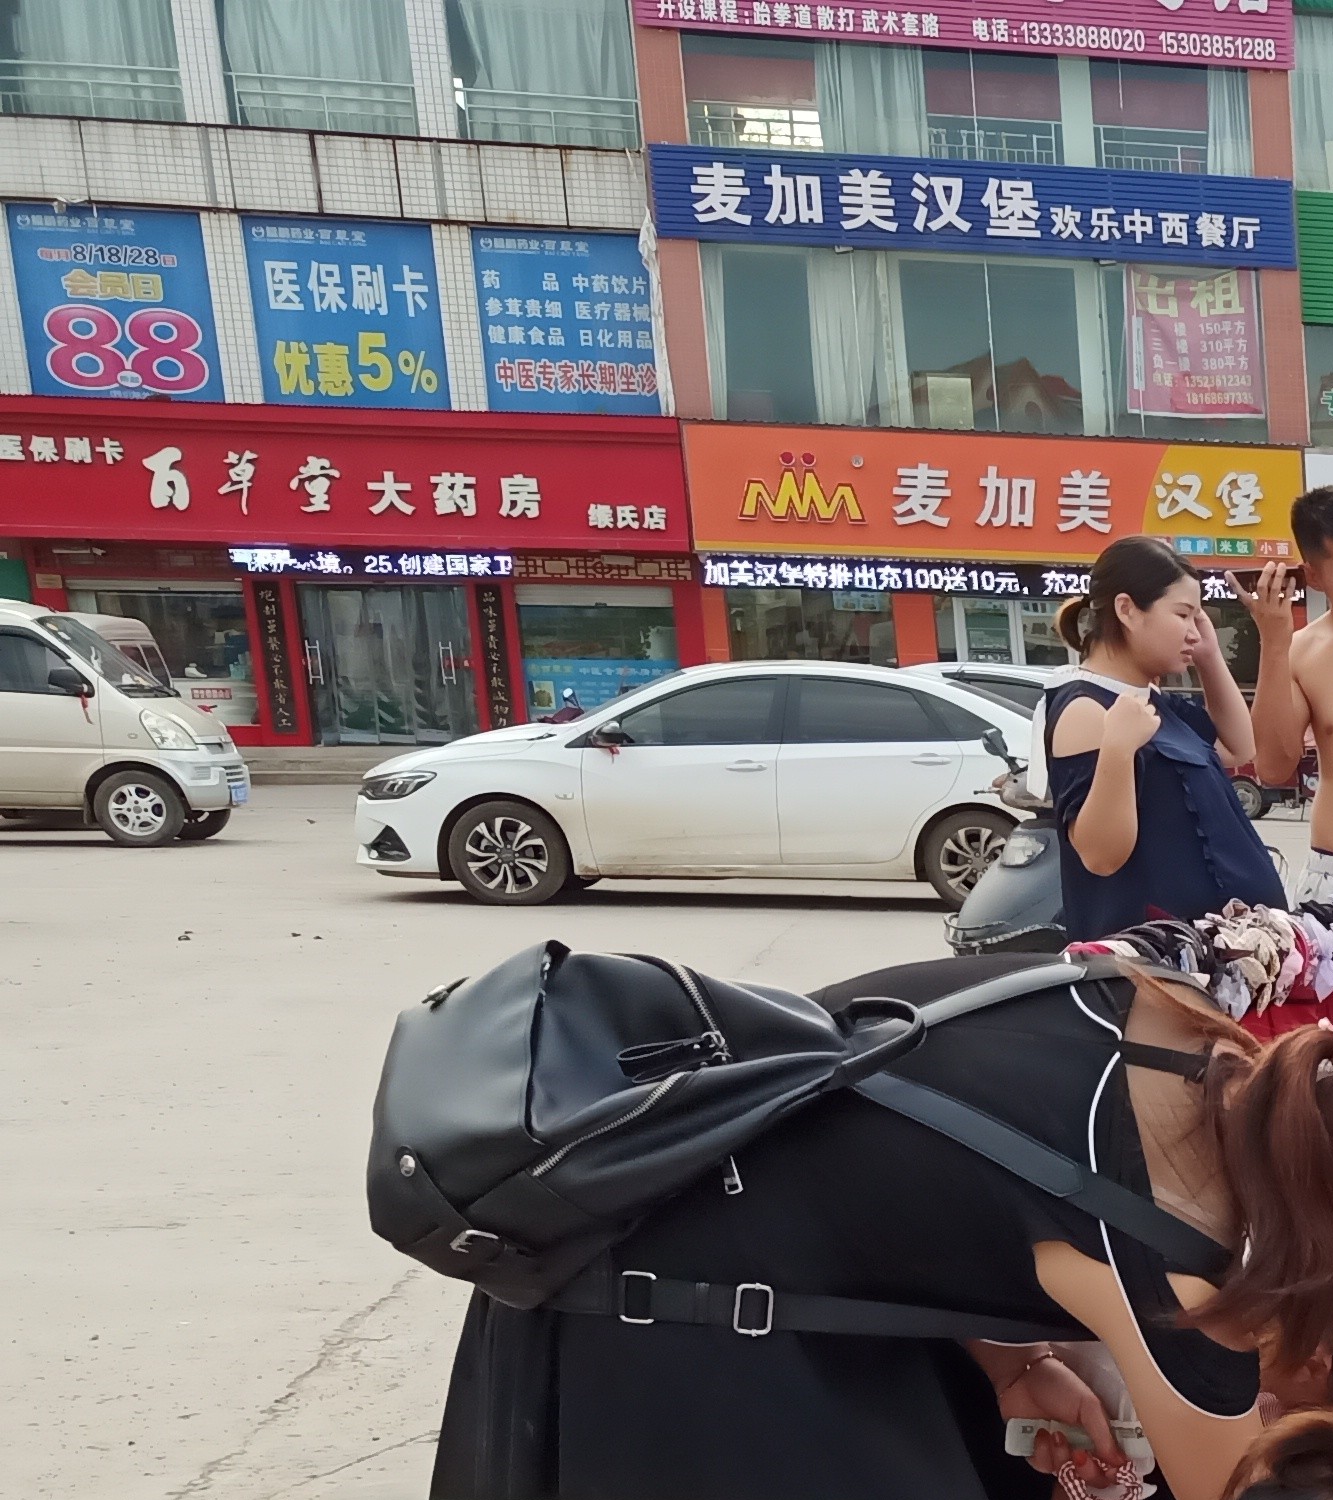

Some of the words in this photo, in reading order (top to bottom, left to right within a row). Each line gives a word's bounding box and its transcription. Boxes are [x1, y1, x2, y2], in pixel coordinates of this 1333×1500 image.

[1159, 31, 1276, 61] 15303851288
[690, 162, 1042, 239] 麦加美汉堡
[1050, 204, 1261, 251] 欢乐中西餐厅
[61, 269, 163, 302] 会员日
[264, 260, 429, 318] 医保刷卡
[572, 273, 647, 295] 中药饮片
[1135, 270, 1245, 317] 出租
[485, 297, 563, 319] 参茸贵细
[575, 301, 651, 322] 医疗器械
[488, 325, 565, 347] 健康食品
[579, 329, 653, 349] 日化用品
[274, 332, 438, 396] 优惠5%
[495, 357, 659, 396] 中医专家长期坐诊
[892, 462, 1112, 533] 麦加美
[1155, 471, 1264, 527] 汉堡
[1219, 539, 1250, 554] 米饭
[1260, 541, 1290, 556] 小面
